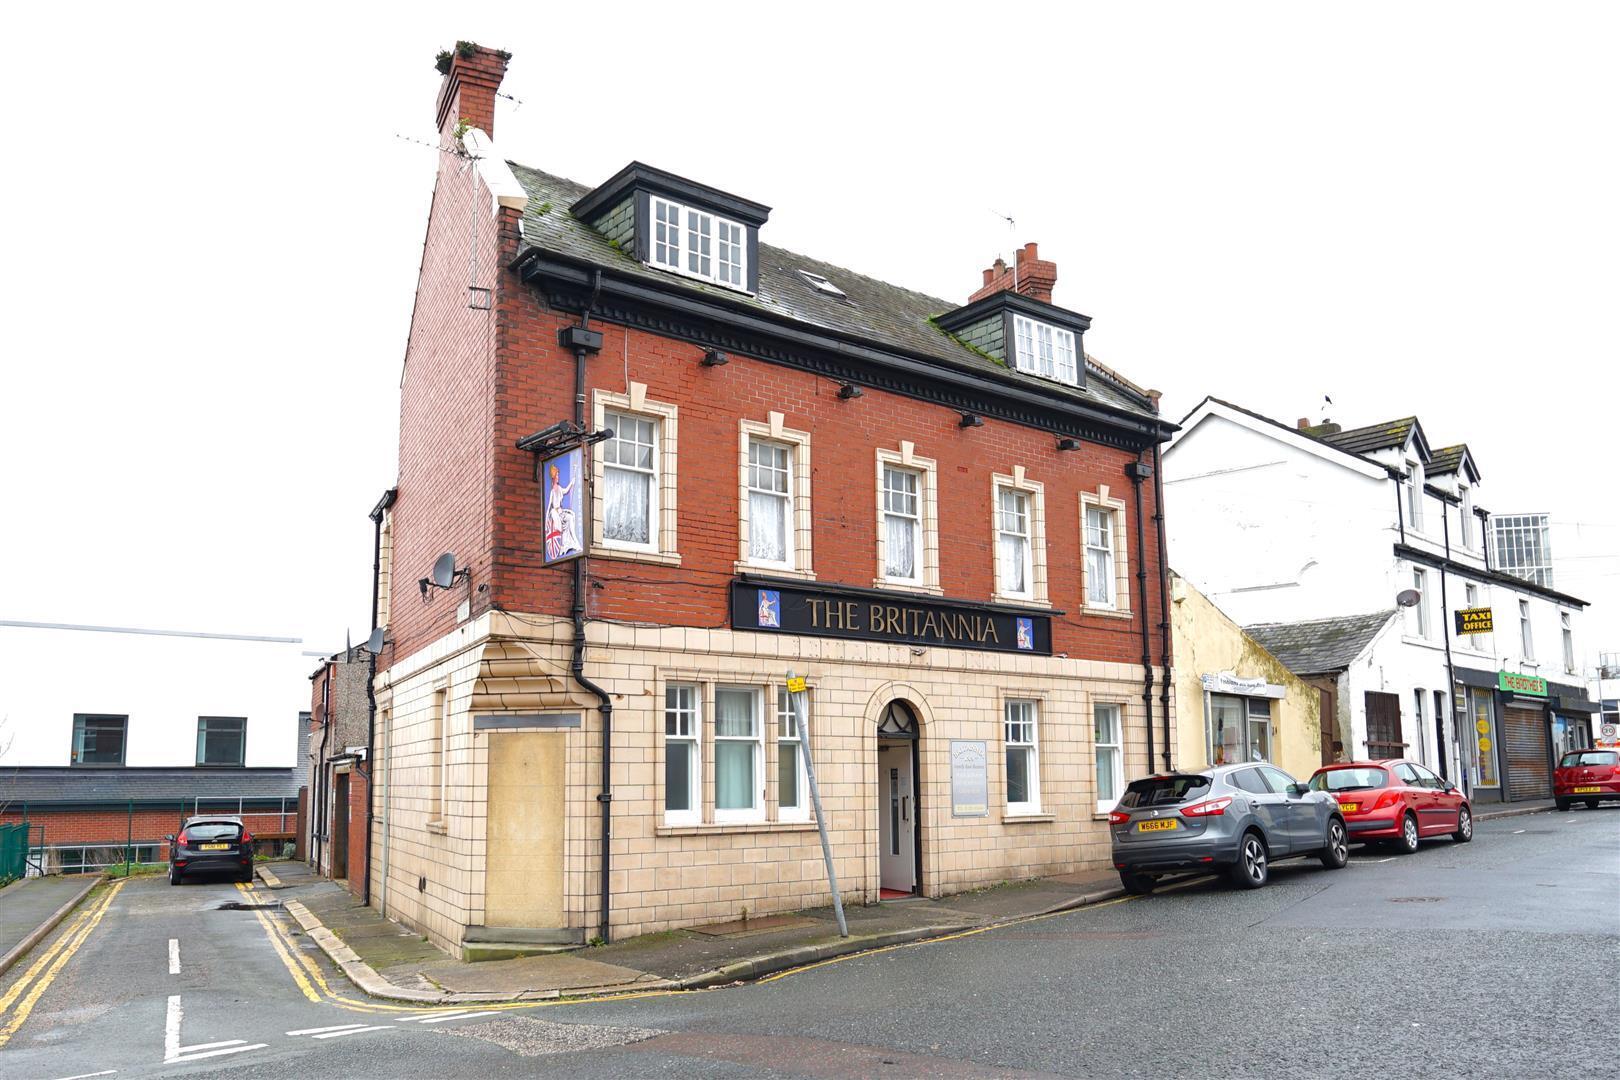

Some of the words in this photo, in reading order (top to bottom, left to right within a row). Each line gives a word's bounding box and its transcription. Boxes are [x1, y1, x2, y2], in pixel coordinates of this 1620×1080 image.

[805, 599, 860, 631] THE
[869, 604, 999, 643] BRITANNIA
[1462, 612, 1492, 621] TAXI
[1463, 620, 1493, 630] OFFICE
[1504, 675, 1515, 689] THE
[1141, 822, 1159, 831] W666
